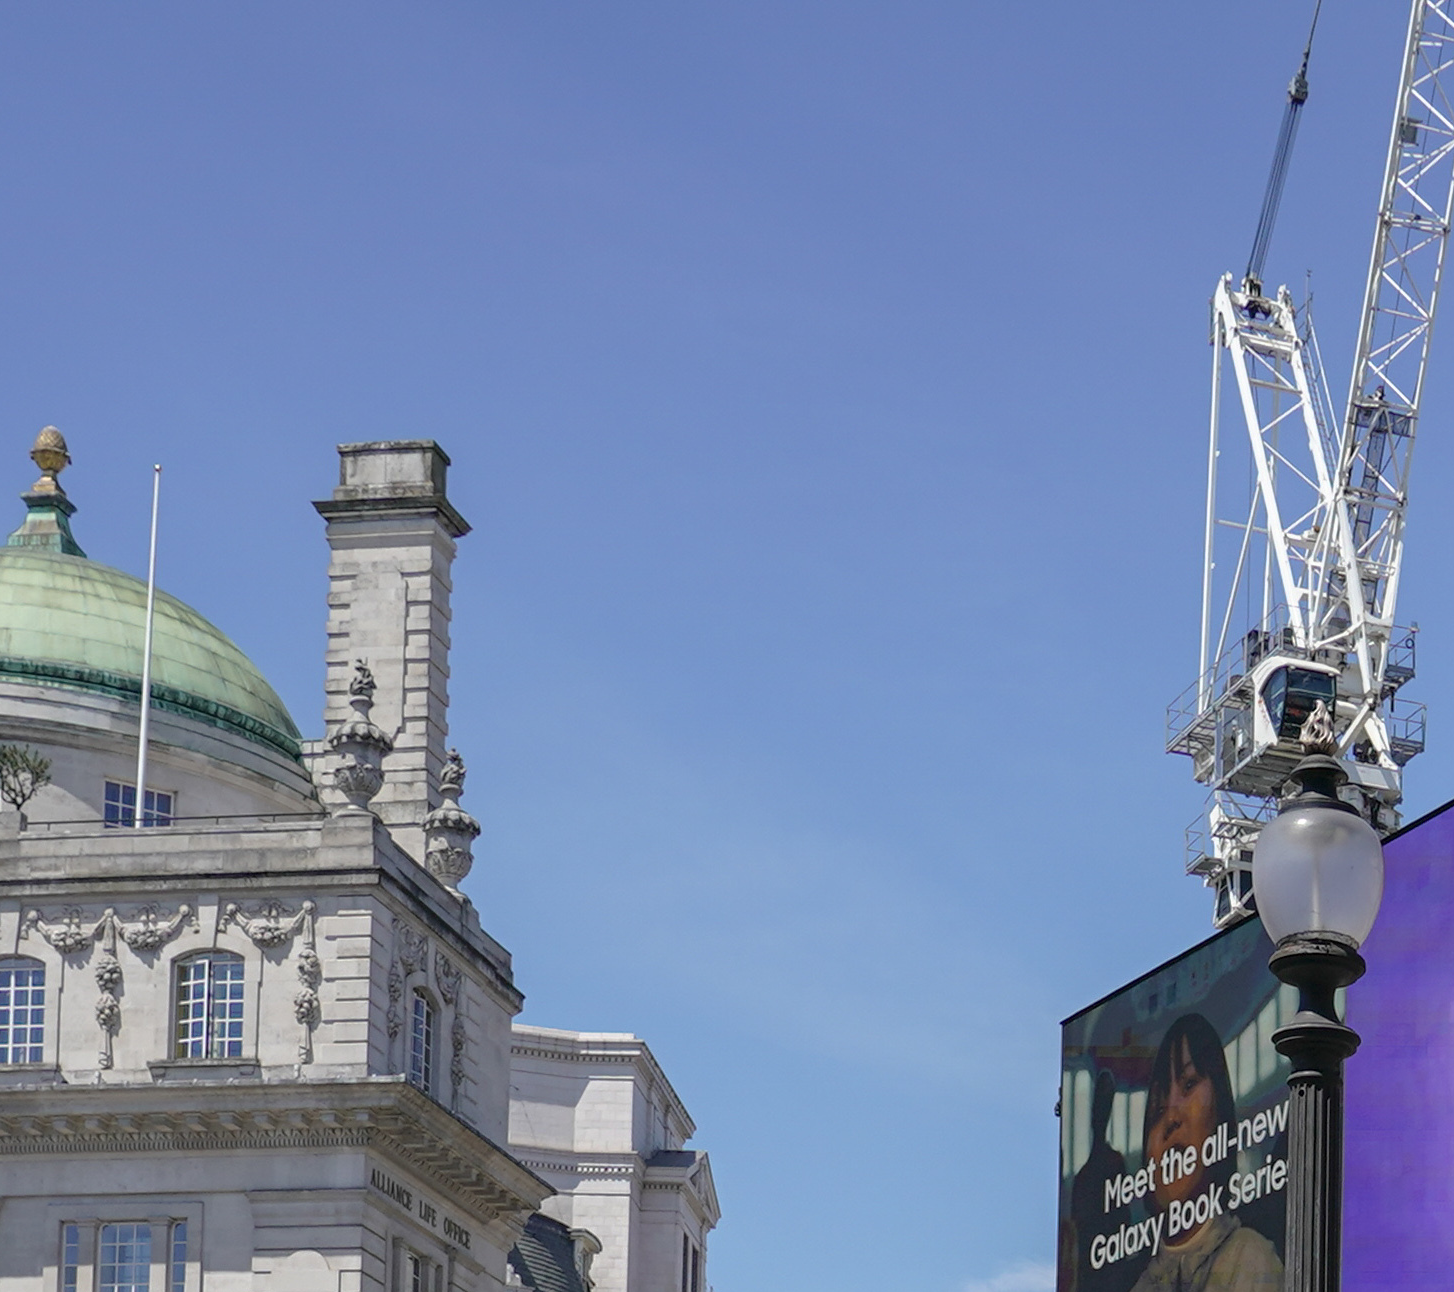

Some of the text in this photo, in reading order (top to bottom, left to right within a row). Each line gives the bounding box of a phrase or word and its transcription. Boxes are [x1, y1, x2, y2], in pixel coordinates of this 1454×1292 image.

[371, 1168, 471, 1250] ALLIANCE LIFE OFFICE
[1090, 1154, 1289, 1270] Galaxy Book Serie
[1104, 1100, 1289, 1215] Meet the all-new
